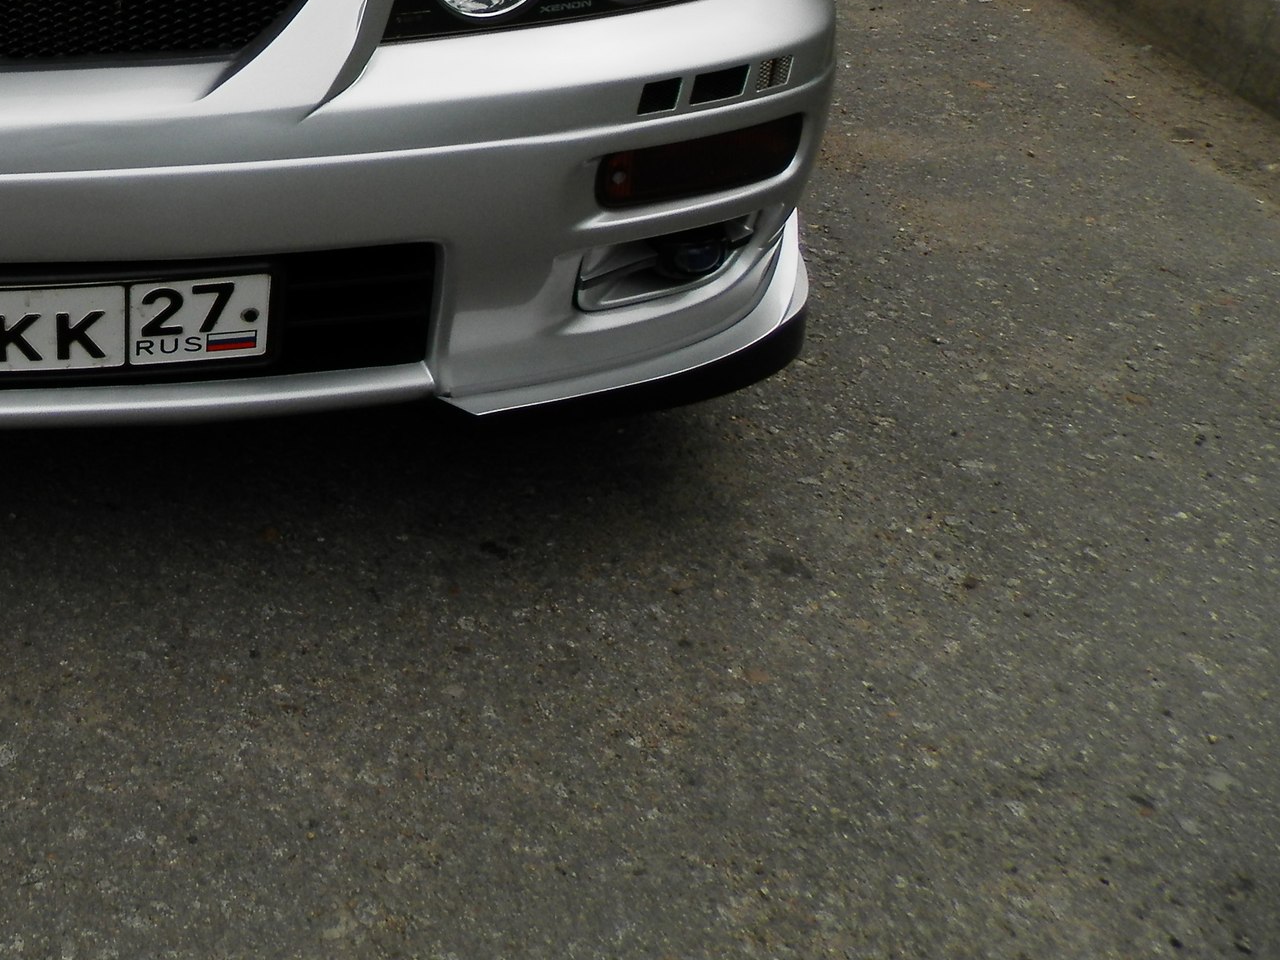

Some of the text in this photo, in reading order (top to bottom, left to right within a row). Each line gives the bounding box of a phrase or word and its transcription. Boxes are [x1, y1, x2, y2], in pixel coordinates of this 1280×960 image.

[540, 0, 592, 14] XENON
[141, 281, 235, 337] 27
[135, 336, 203, 356] RUS
